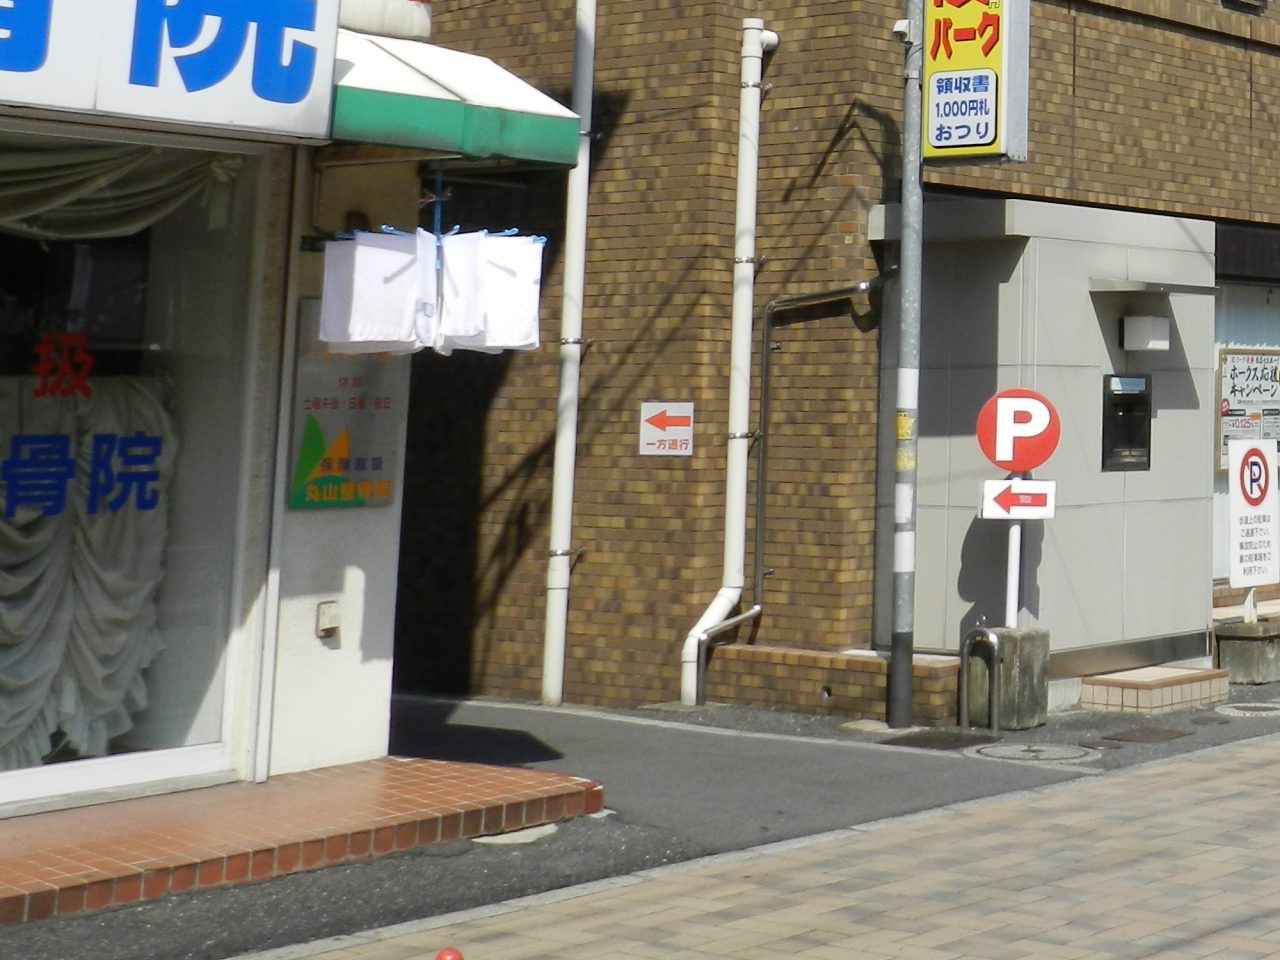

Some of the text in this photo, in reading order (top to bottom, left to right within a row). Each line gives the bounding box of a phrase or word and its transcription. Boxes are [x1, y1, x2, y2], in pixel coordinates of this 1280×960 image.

[930, 11, 1000, 60] パーク
[936, 75, 990, 94] 領収書
[935, 122, 989, 142] おつり
[32, 331, 95, 399] 扱
[1230, 383, 1278, 398] キャンペーン
[646, 439, 690, 450] 一方通行
[996, 397, 1050, 461] P
[1, 431, 163, 519] 骨院
